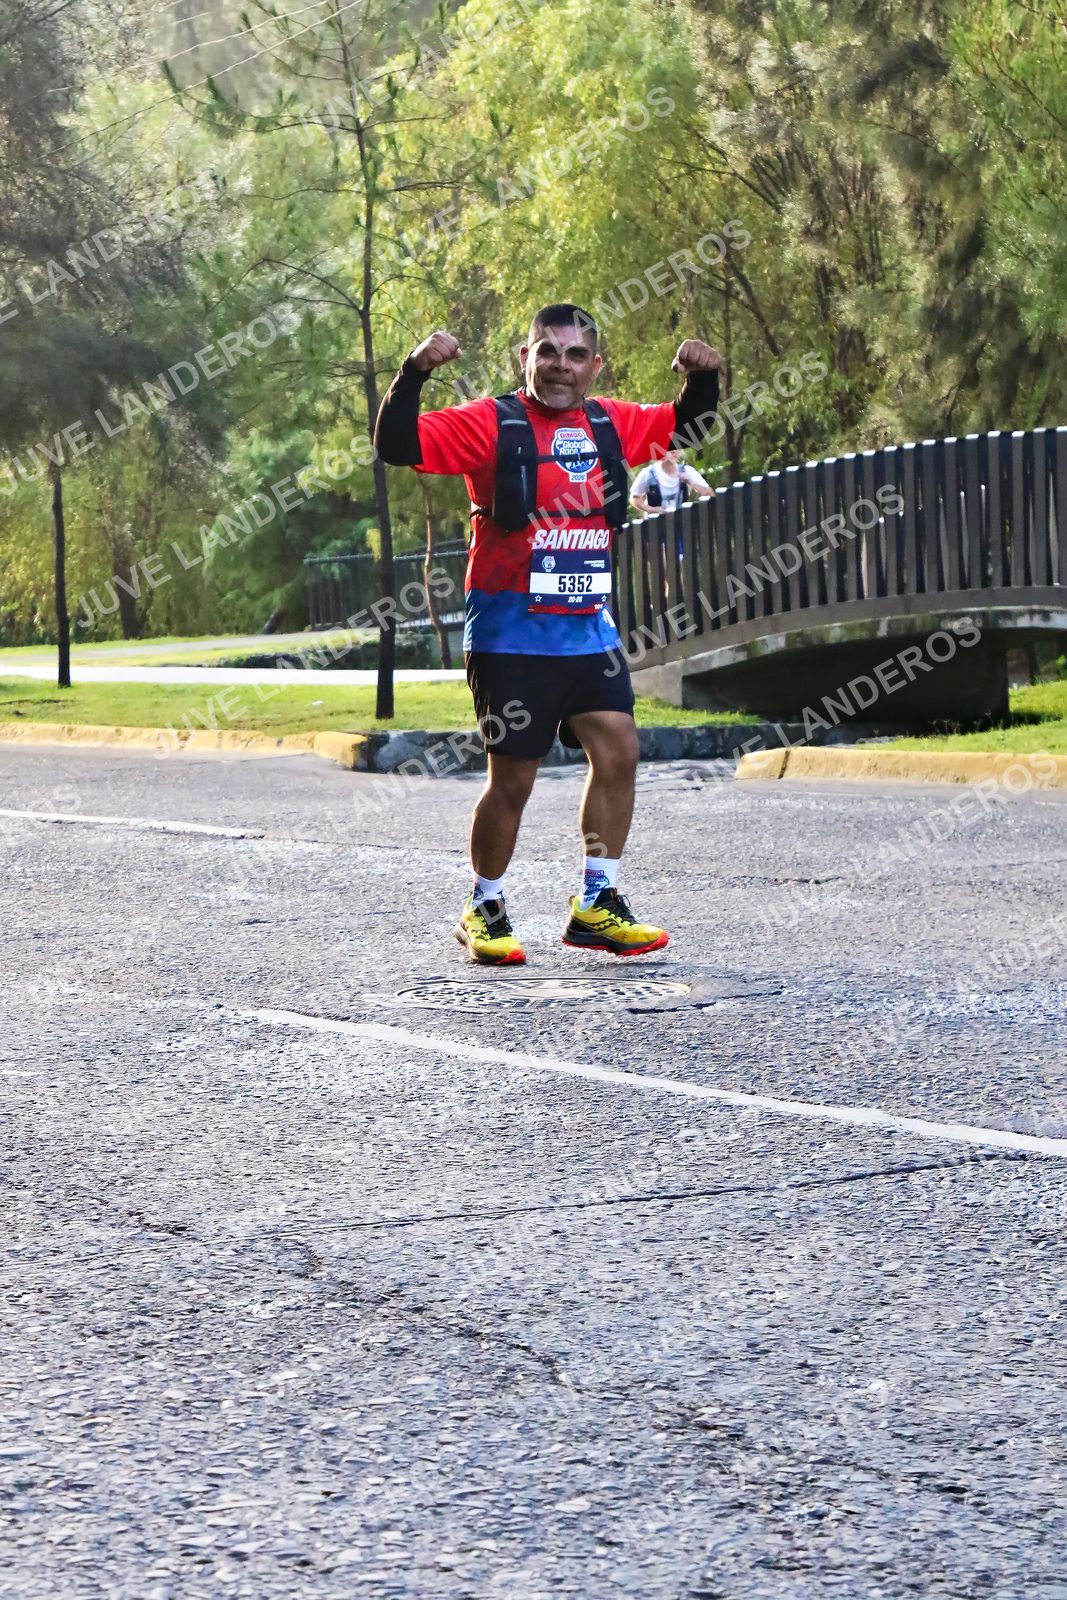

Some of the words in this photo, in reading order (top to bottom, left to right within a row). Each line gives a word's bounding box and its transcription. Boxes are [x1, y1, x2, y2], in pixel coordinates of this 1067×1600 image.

[562, 440, 586, 450] Global
[532, 529, 609, 550] SANTIAGO
[558, 575, 593, 593] 5352
